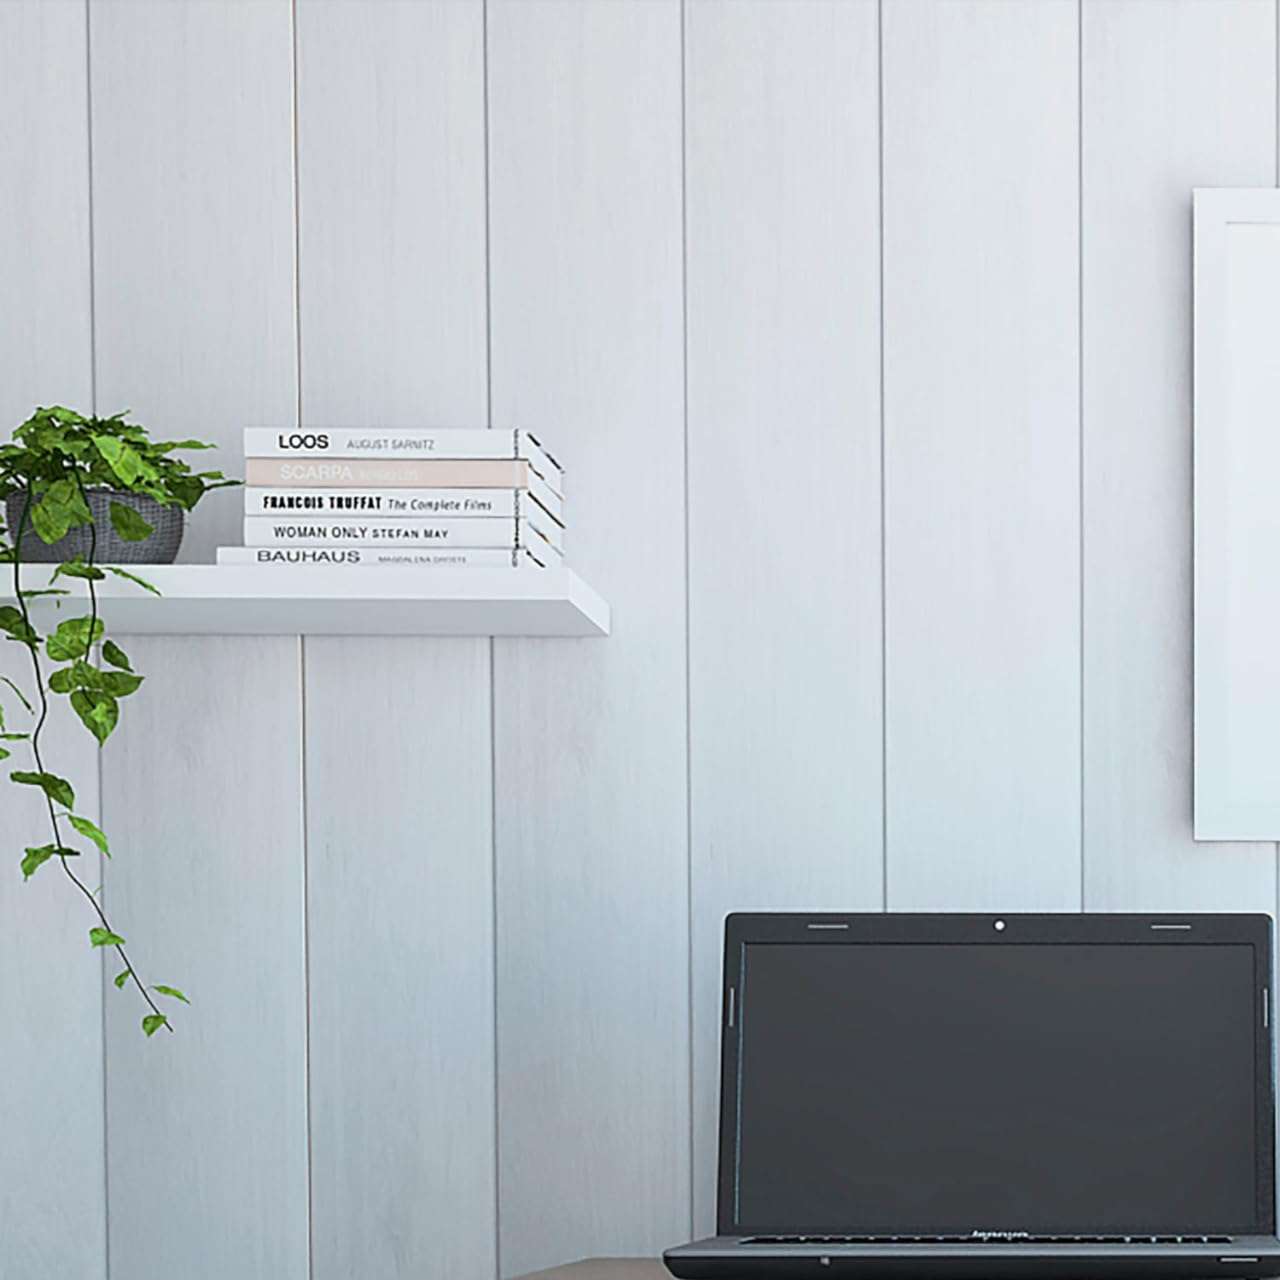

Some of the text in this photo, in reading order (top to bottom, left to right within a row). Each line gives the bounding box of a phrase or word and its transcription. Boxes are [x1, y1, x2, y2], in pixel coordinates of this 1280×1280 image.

[278, 434, 329, 449] LOOS
[346, 440, 388, 450] AUGUST
[280, 464, 353, 481] SCARPA
[263, 496, 324, 509] FRANCOIS
[388, 499, 407, 510] The
[410, 499, 461, 511] Complete
[463, 499, 492, 511] Films
[273, 526, 449, 539] WOMAN ONLY STEFAN MAY
[257, 550, 361, 563] BAUHAUS
